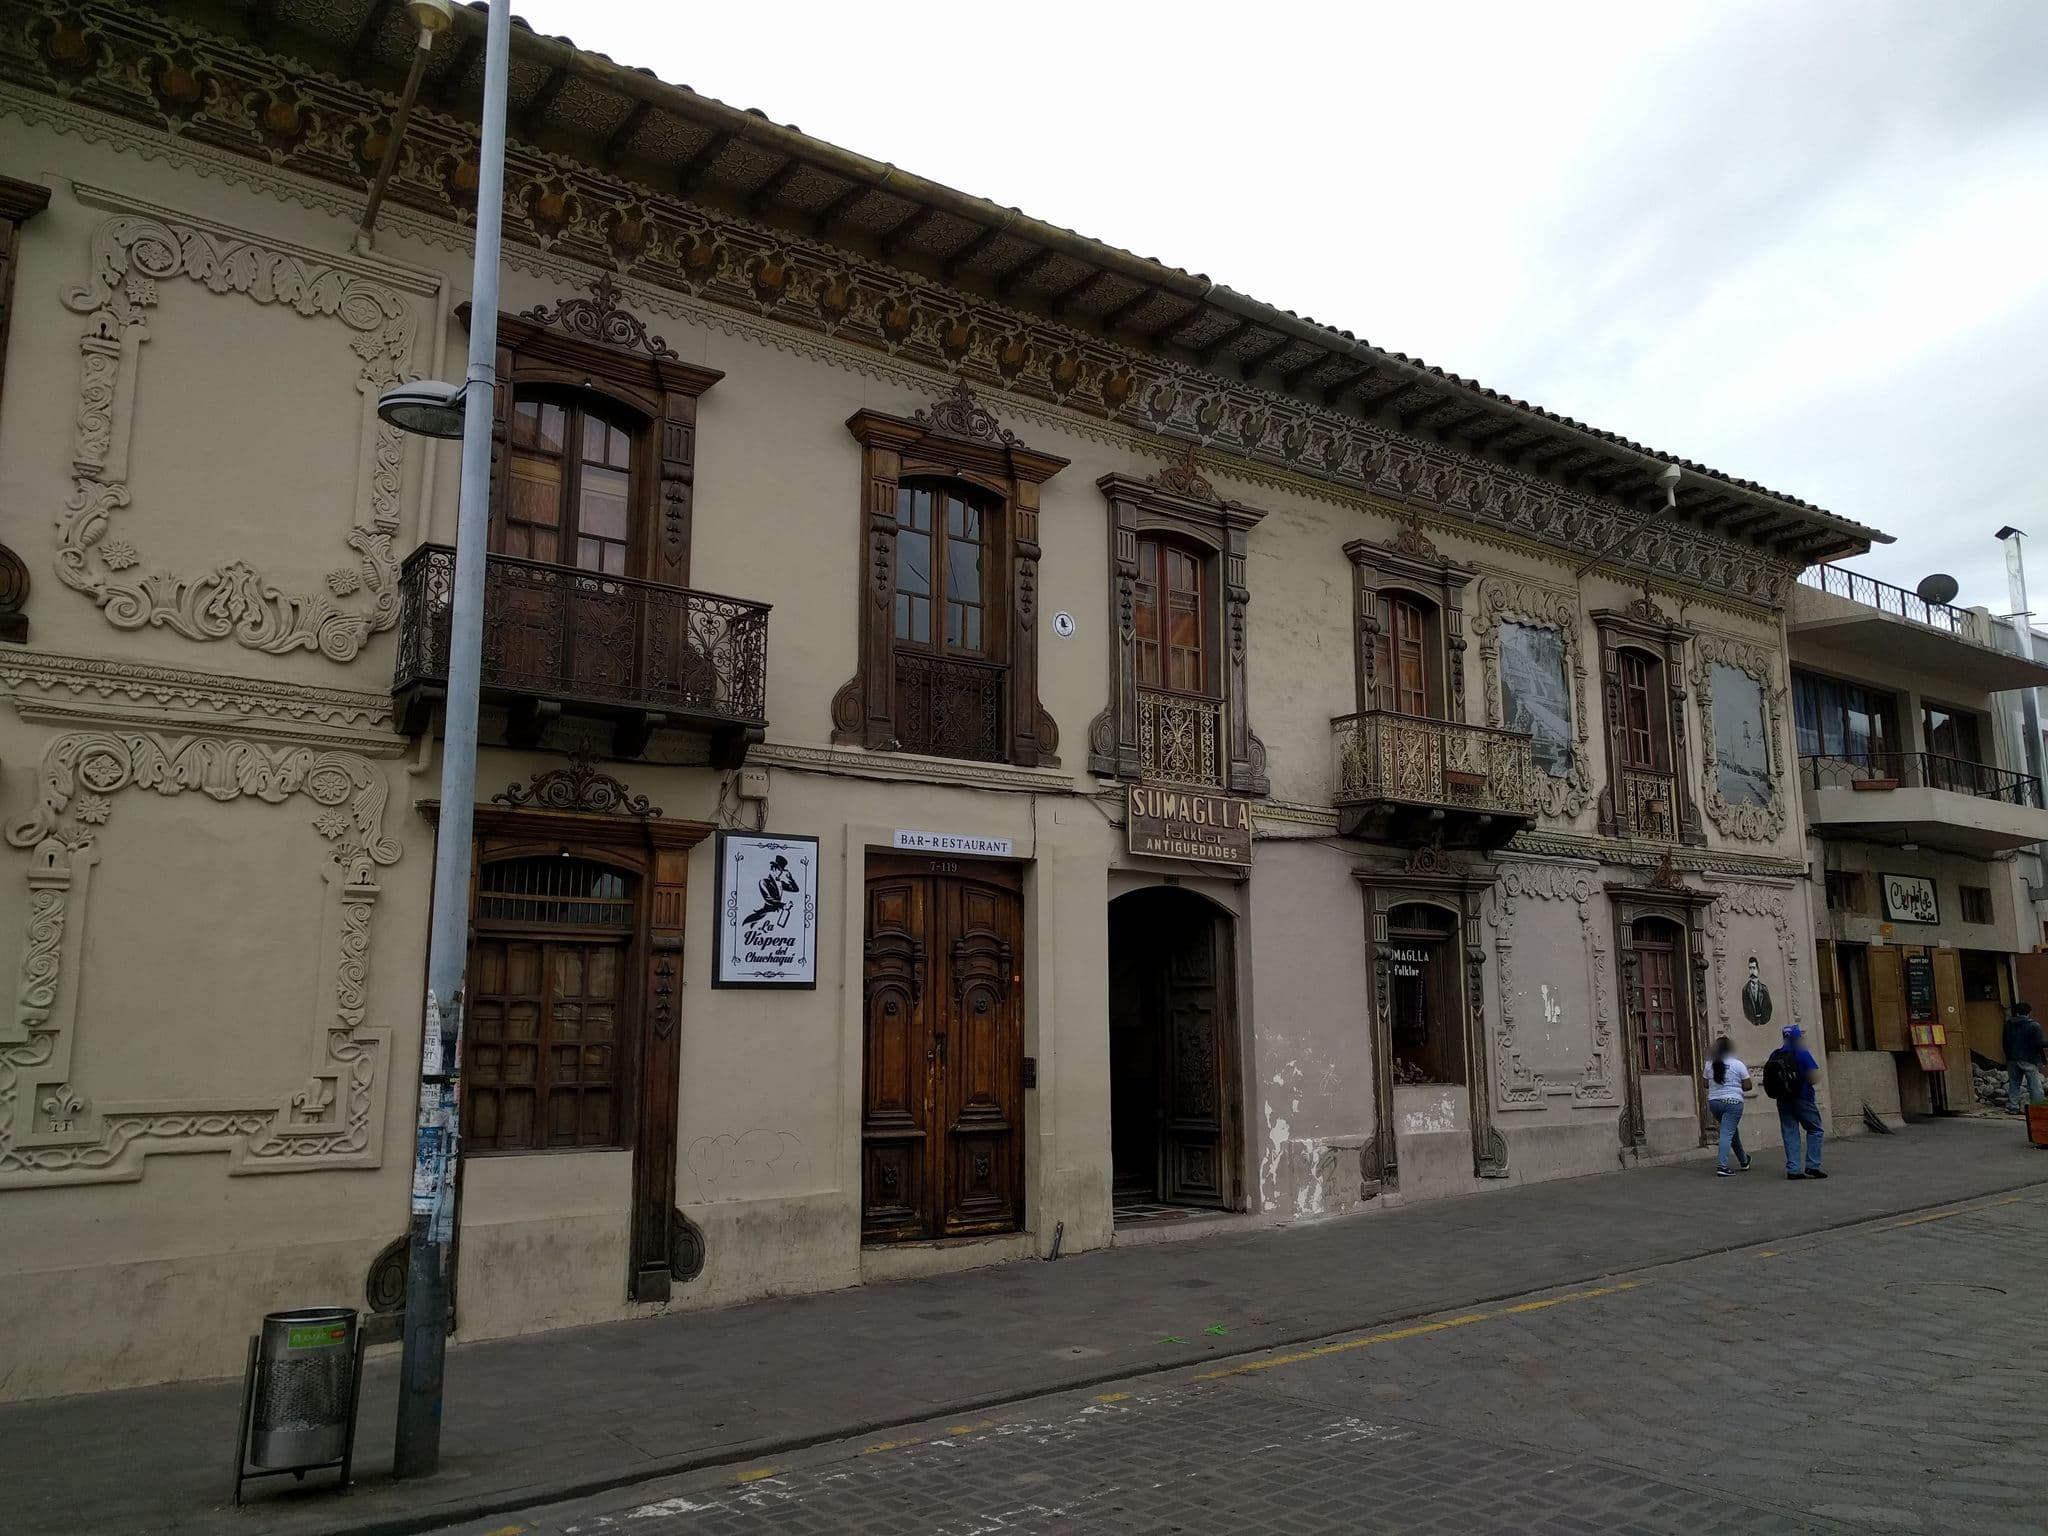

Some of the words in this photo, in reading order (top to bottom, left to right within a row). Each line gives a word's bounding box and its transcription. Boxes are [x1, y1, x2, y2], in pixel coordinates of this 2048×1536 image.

[1132, 788, 1249, 831] SUMAGLLA
[901, 834, 1008, 852] BAR-RESTAURANT
[1146, 838, 1238, 859] ANTIGUEDADES
[930, 862, 958, 873] 7-119
[758, 920, 774, 933] La
[744, 931, 796, 950] Víspera
[775, 947, 788, 955] del
[1390, 949, 1429, 961] UMAGLLA
